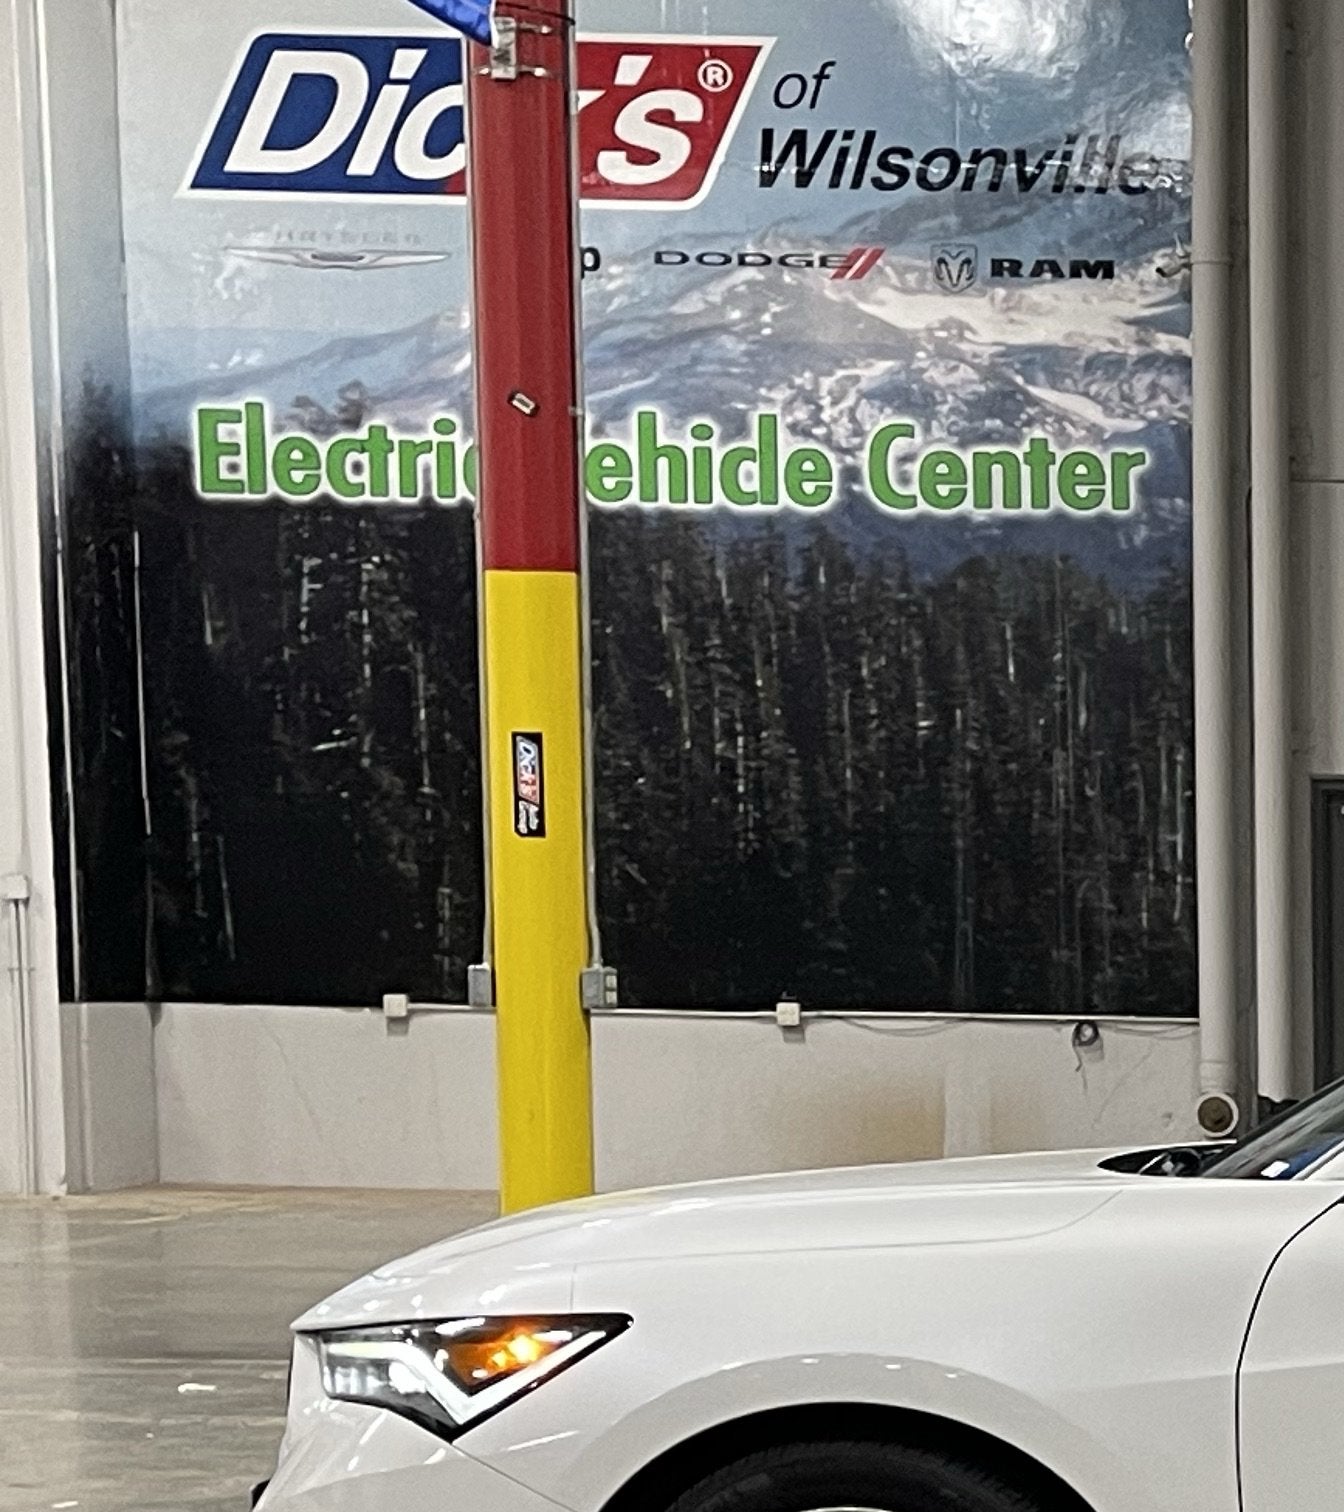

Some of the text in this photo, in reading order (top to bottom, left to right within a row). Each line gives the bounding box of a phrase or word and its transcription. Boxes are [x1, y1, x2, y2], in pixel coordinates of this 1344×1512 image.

[774, 61, 837, 109] of
[654, 250, 853, 269] DODGE
[990, 257, 1115, 280] RAM
[585, 411, 833, 507] ehicle
[868, 423, 1145, 511] Center
